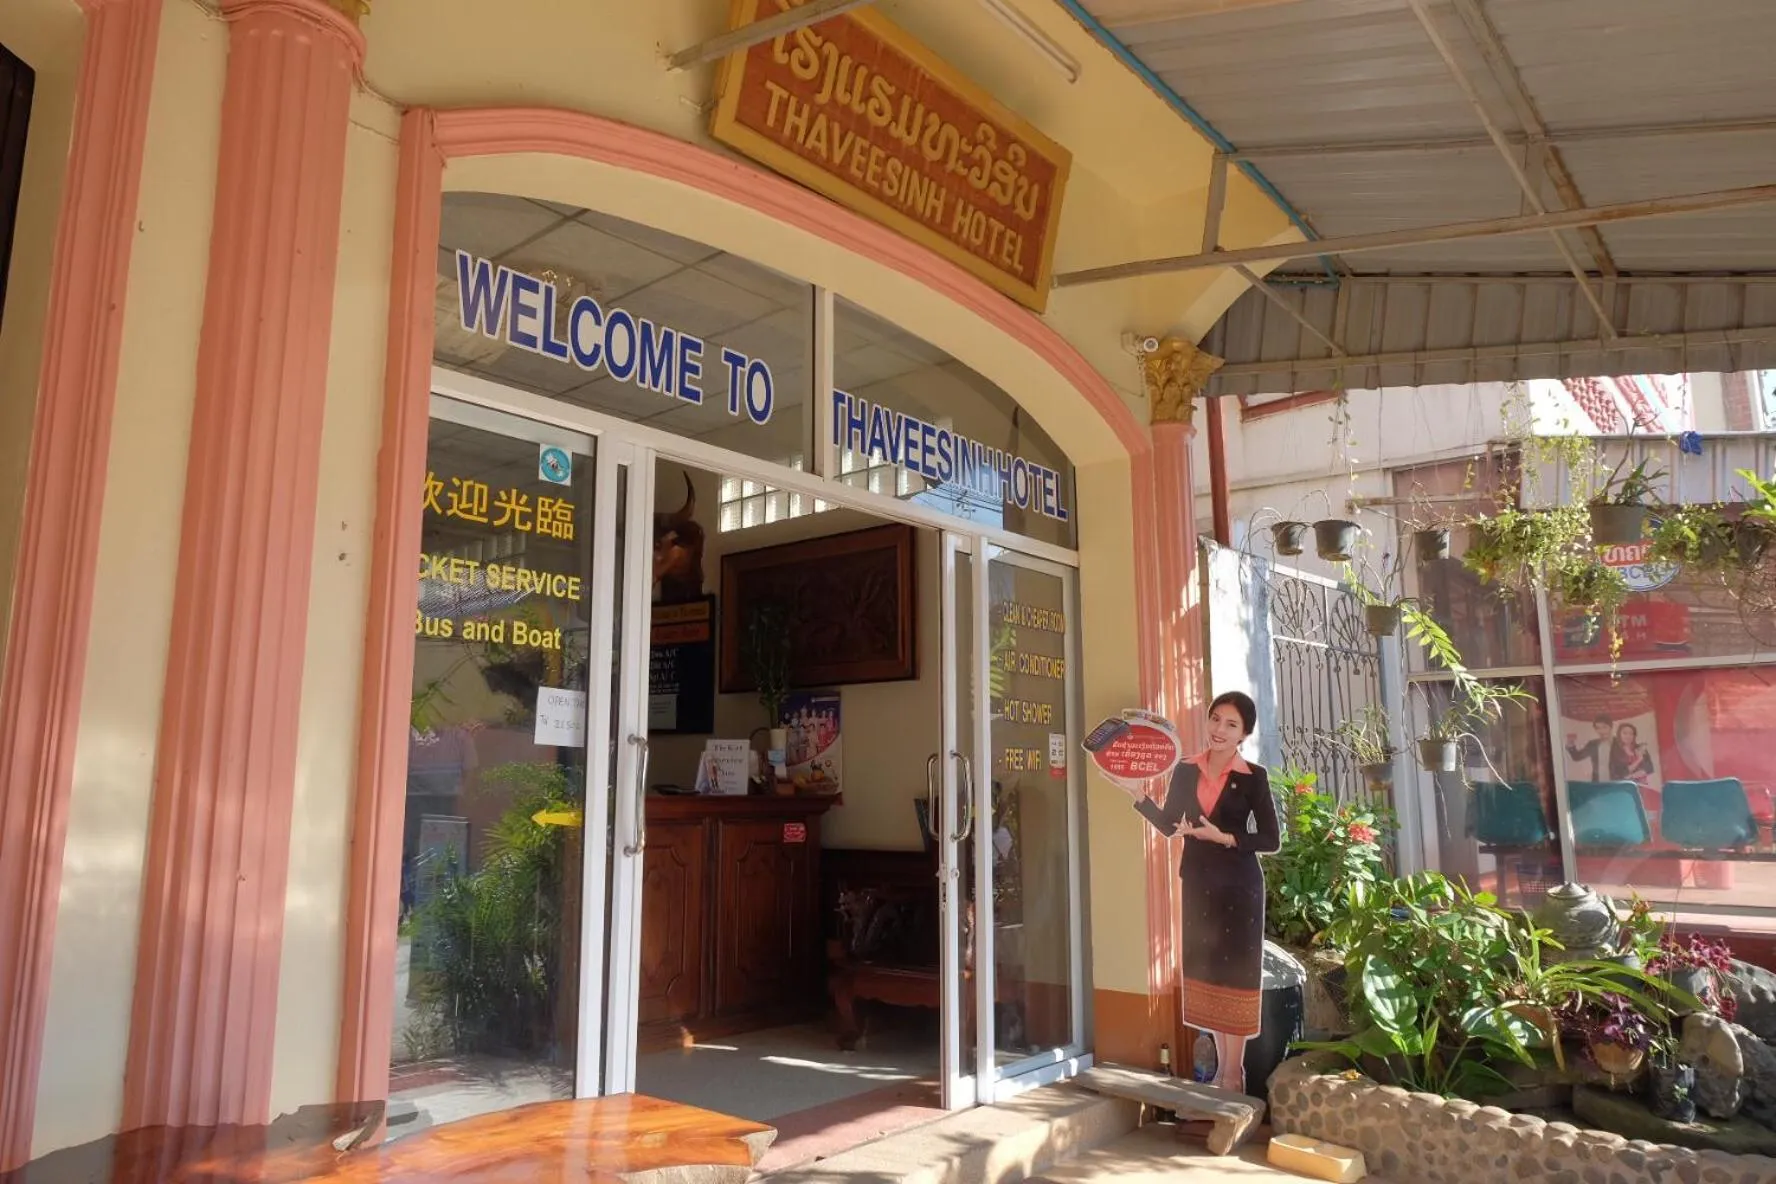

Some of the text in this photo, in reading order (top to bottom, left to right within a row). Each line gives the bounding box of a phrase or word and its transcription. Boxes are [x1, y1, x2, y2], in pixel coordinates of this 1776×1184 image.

[764, 79, 1024, 274] THAVEESINH HOTEL
[456, 248, 775, 425] WELCOME TO
[832, 387, 1068, 522] THAVEESINH HOTEL
[486, 563, 582, 601] SERVICE
[462, 620, 505, 644] and
[512, 620, 562, 651] Boat
[1004, 699, 1052, 726] HOT SHOWER
[1005, 747, 1025, 772] FREE
[1129, 760, 1160, 773] BCEL
